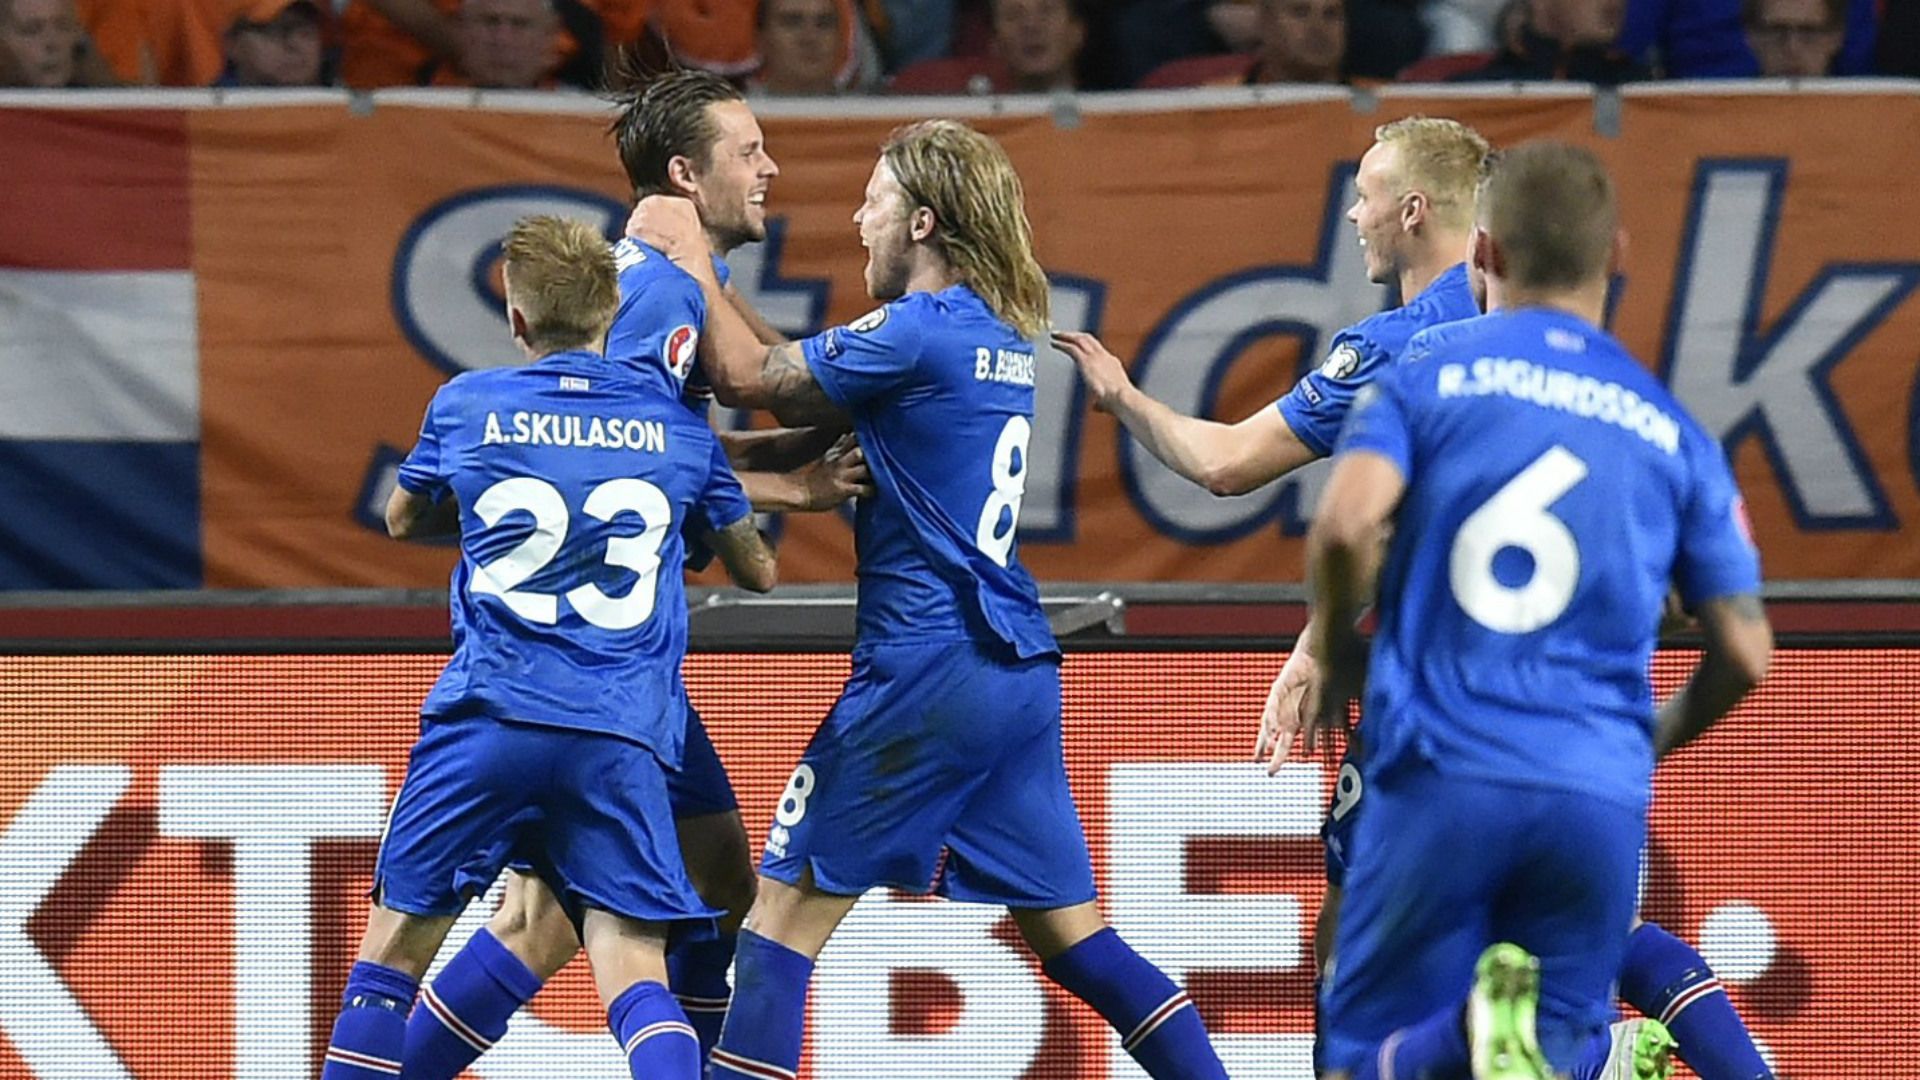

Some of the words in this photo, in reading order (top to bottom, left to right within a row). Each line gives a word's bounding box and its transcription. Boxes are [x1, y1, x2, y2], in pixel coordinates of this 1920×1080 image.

[483, 412, 666, 453] A.SKULASON
[1437, 357, 1680, 455] R.SIGURDSSON
[976, 415, 1031, 567] 8
[1449, 445, 1590, 635] 6
[469, 477, 672, 630] 23
[776, 763, 815, 826] 8
[1332, 762, 1362, 822] 9
